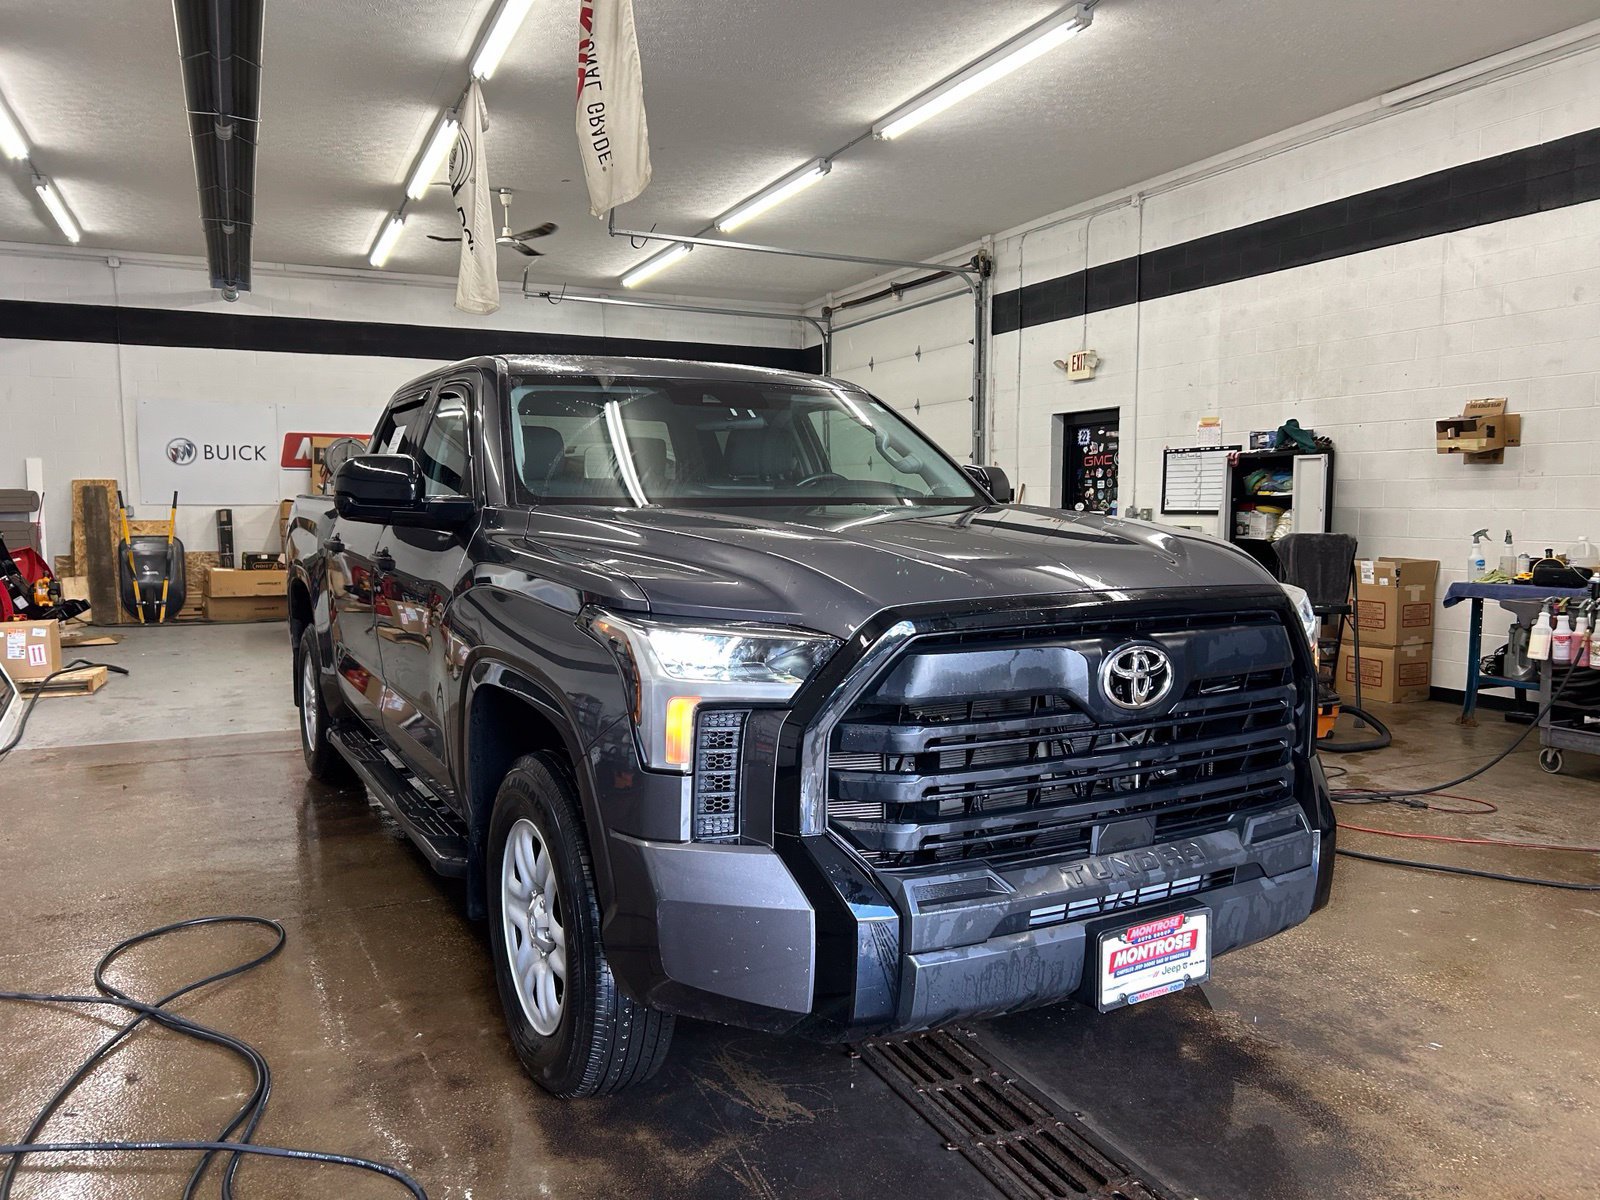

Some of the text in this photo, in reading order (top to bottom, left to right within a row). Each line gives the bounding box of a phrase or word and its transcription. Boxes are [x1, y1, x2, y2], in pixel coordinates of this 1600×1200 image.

[1072, 353, 1087, 372] EXIT
[203, 444, 267, 461] BUICK
[1084, 455, 1113, 467] GMC
[1059, 842, 1206, 885] TUNDRA
[1130, 917, 1180, 938] MONTROSE
[1114, 932, 1193, 968] MONTROSE
[1162, 963, 1182, 975] Jeep
[1129, 982, 1184, 1004] GoMontrose.com
